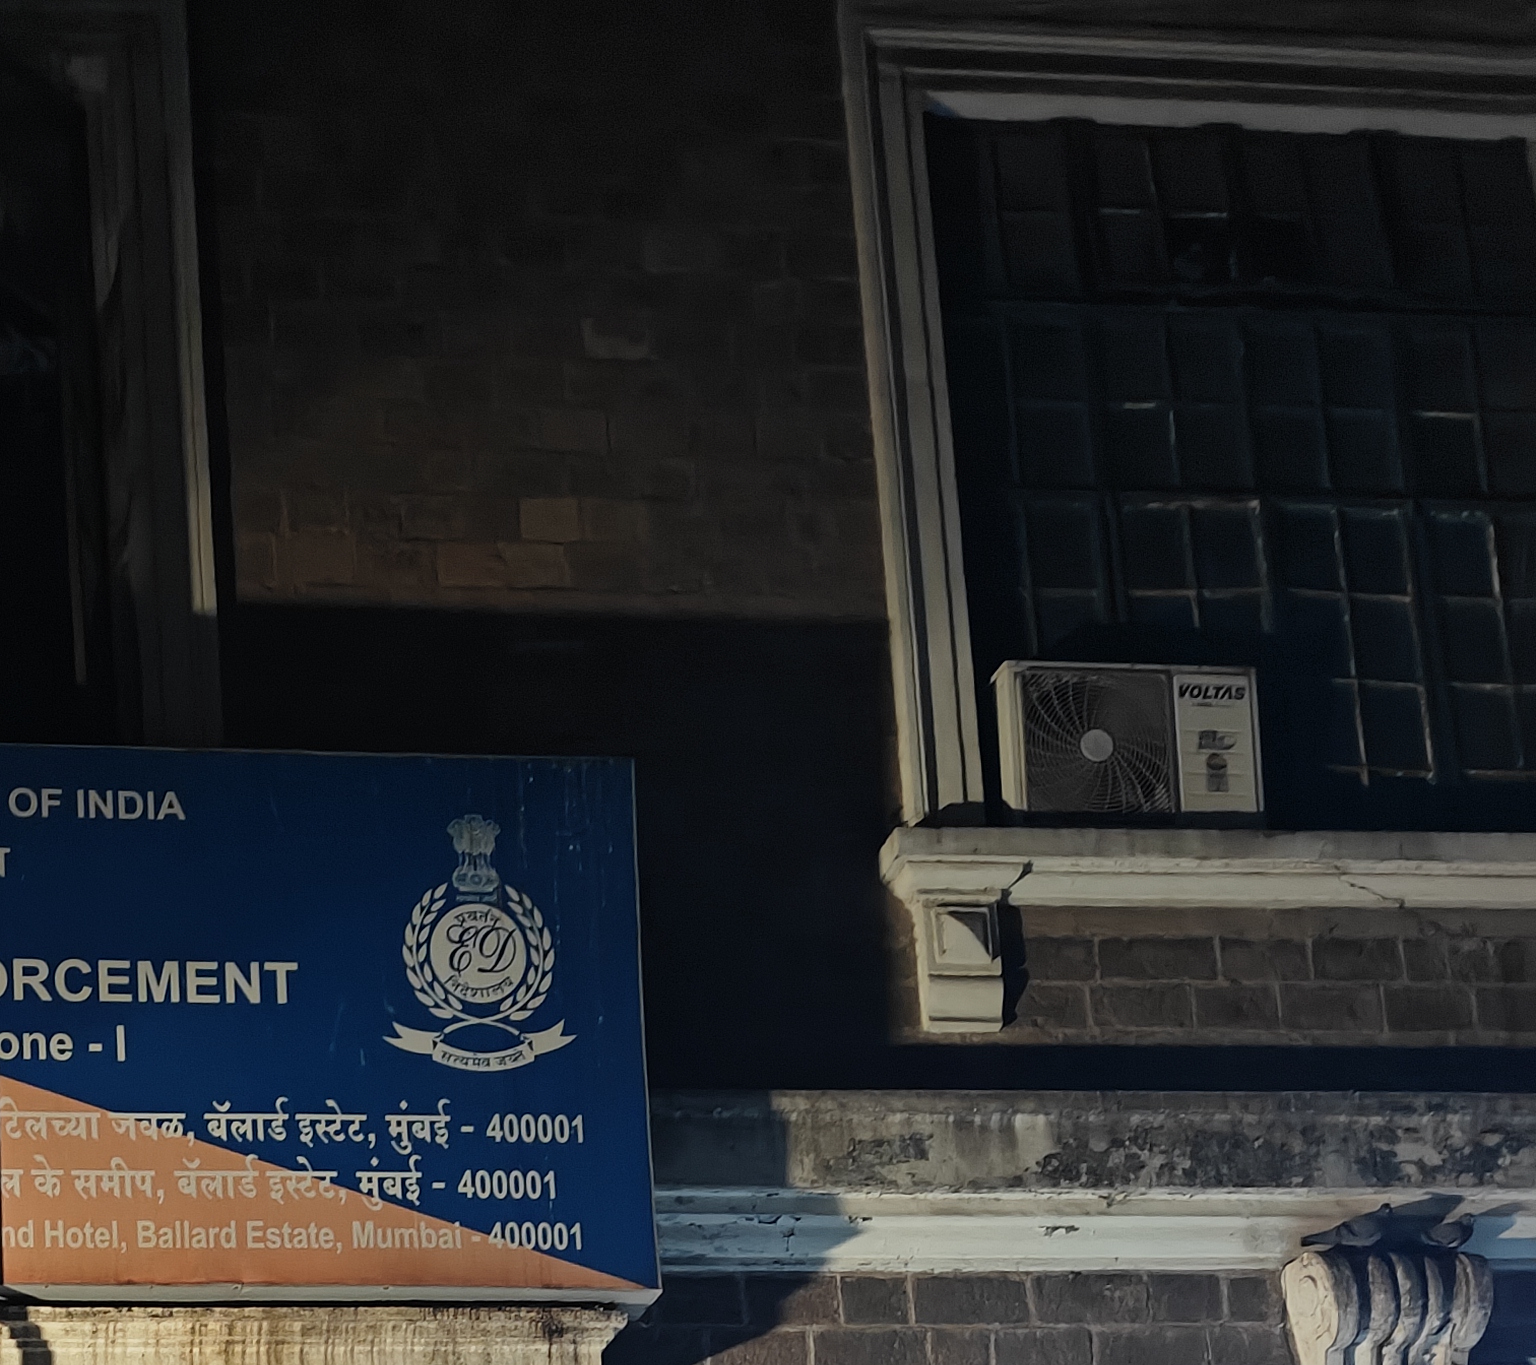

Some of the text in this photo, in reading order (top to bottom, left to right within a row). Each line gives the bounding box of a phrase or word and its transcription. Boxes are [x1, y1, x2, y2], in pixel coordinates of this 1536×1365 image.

[1178, 684, 1246, 700] VOLTAS
[8, 787, 63, 818] OF
[77, 788, 186, 820] INDIA
[108, 1112, 195, 1147] जवळ,
[204, 1097, 288, 1143] बॅलार्ड
[296, 1100, 376, 1148] इस्टेट,
[385, 1099, 451, 1155] मुंबई
[486, 1113, 585, 1145] 400001
[31, 1155, 64, 1199] के
[71, 1157, 166, 1204] समीप,
[174, 1155, 258, 1202] बॅलार्ड
[266, 1157, 347, 1205] इस्टेट,
[356, 1156, 422, 1211] मुंबई
[458, 1169, 557, 1201] 400001
[45, 1220, 128, 1253] Hotel,
[137, 1220, 237, 1250] Ballard
[247, 1220, 343, 1254] Estate,
[352, 1220, 462, 1251] Mumbai
[489, 1221, 583, 1252] 400001
